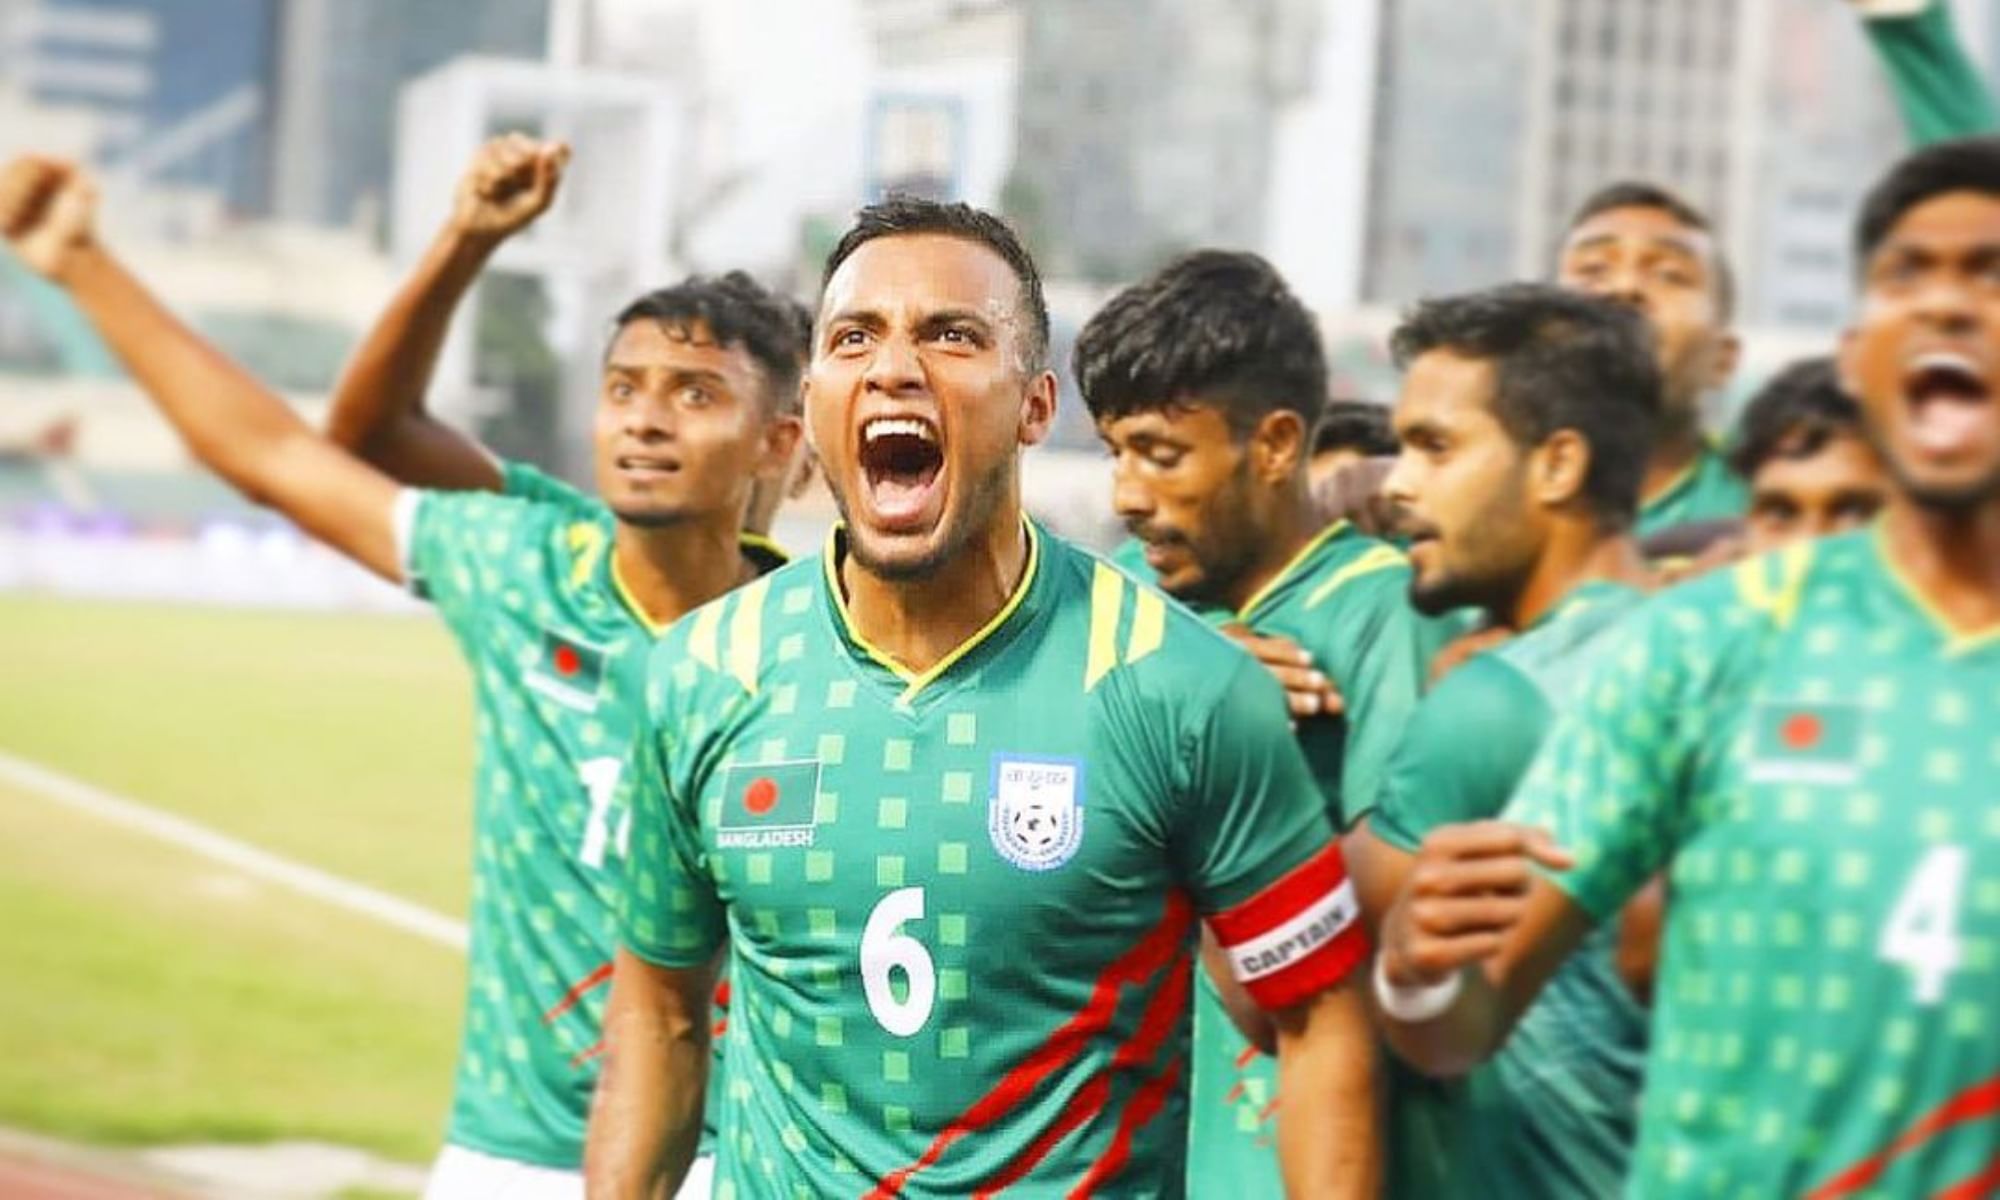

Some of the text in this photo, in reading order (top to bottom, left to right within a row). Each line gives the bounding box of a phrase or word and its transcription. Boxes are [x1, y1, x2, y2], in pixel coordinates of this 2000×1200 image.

[716, 829, 813, 848] BANGLADESH
[860, 887, 936, 1037] 6
[1241, 905, 1345, 974] CAPTAIN
[1877, 844, 1968, 1005] 4
